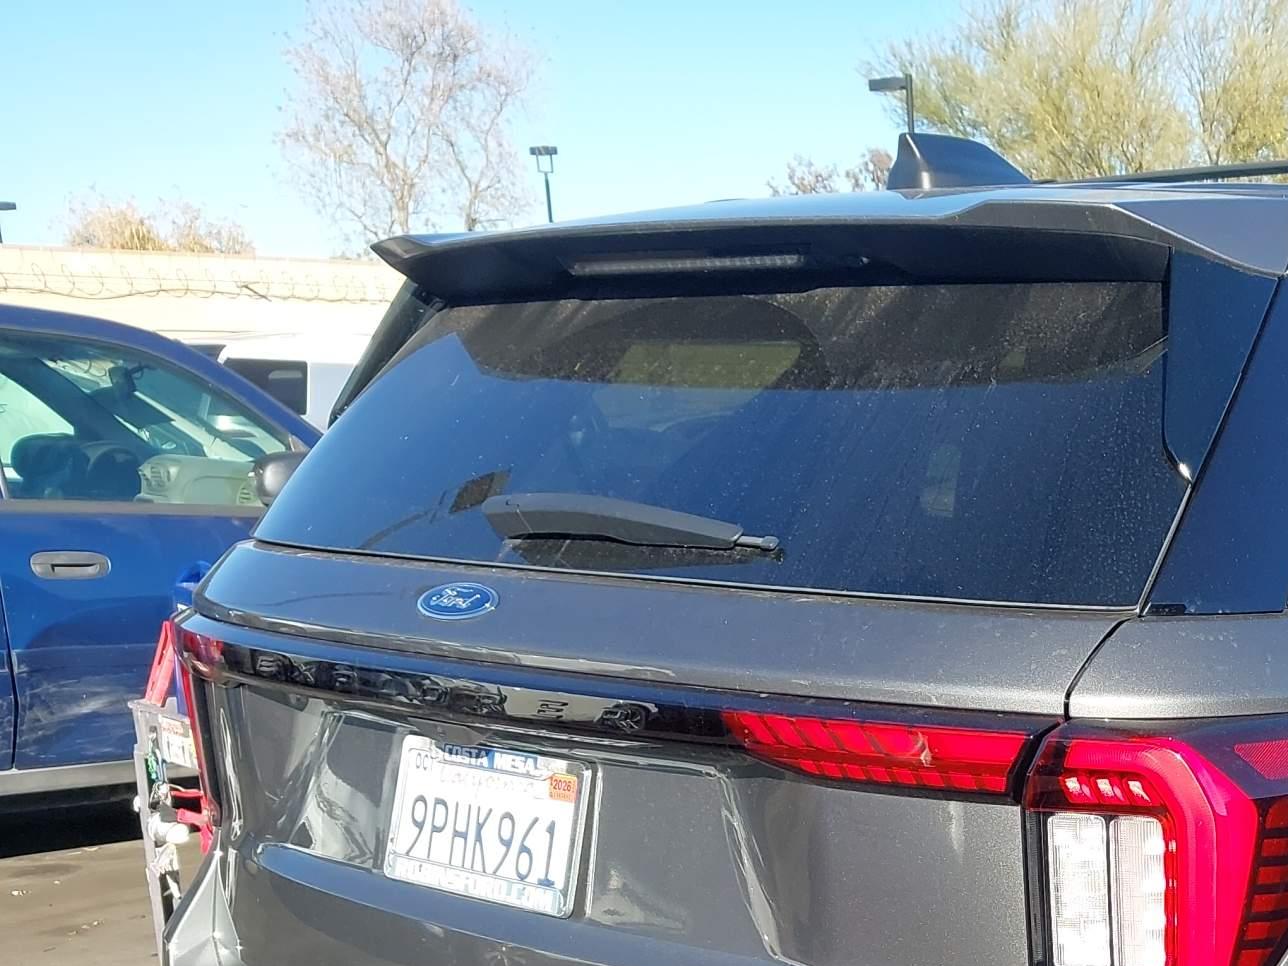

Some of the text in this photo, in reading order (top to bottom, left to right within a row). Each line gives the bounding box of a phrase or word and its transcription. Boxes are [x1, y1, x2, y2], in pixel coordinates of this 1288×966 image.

[430, 586, 481, 609] Ford
[445, 744, 538, 772] COSTA MESA
[553, 778, 572, 792] 2026
[405, 794, 555, 886] 9PHK961
